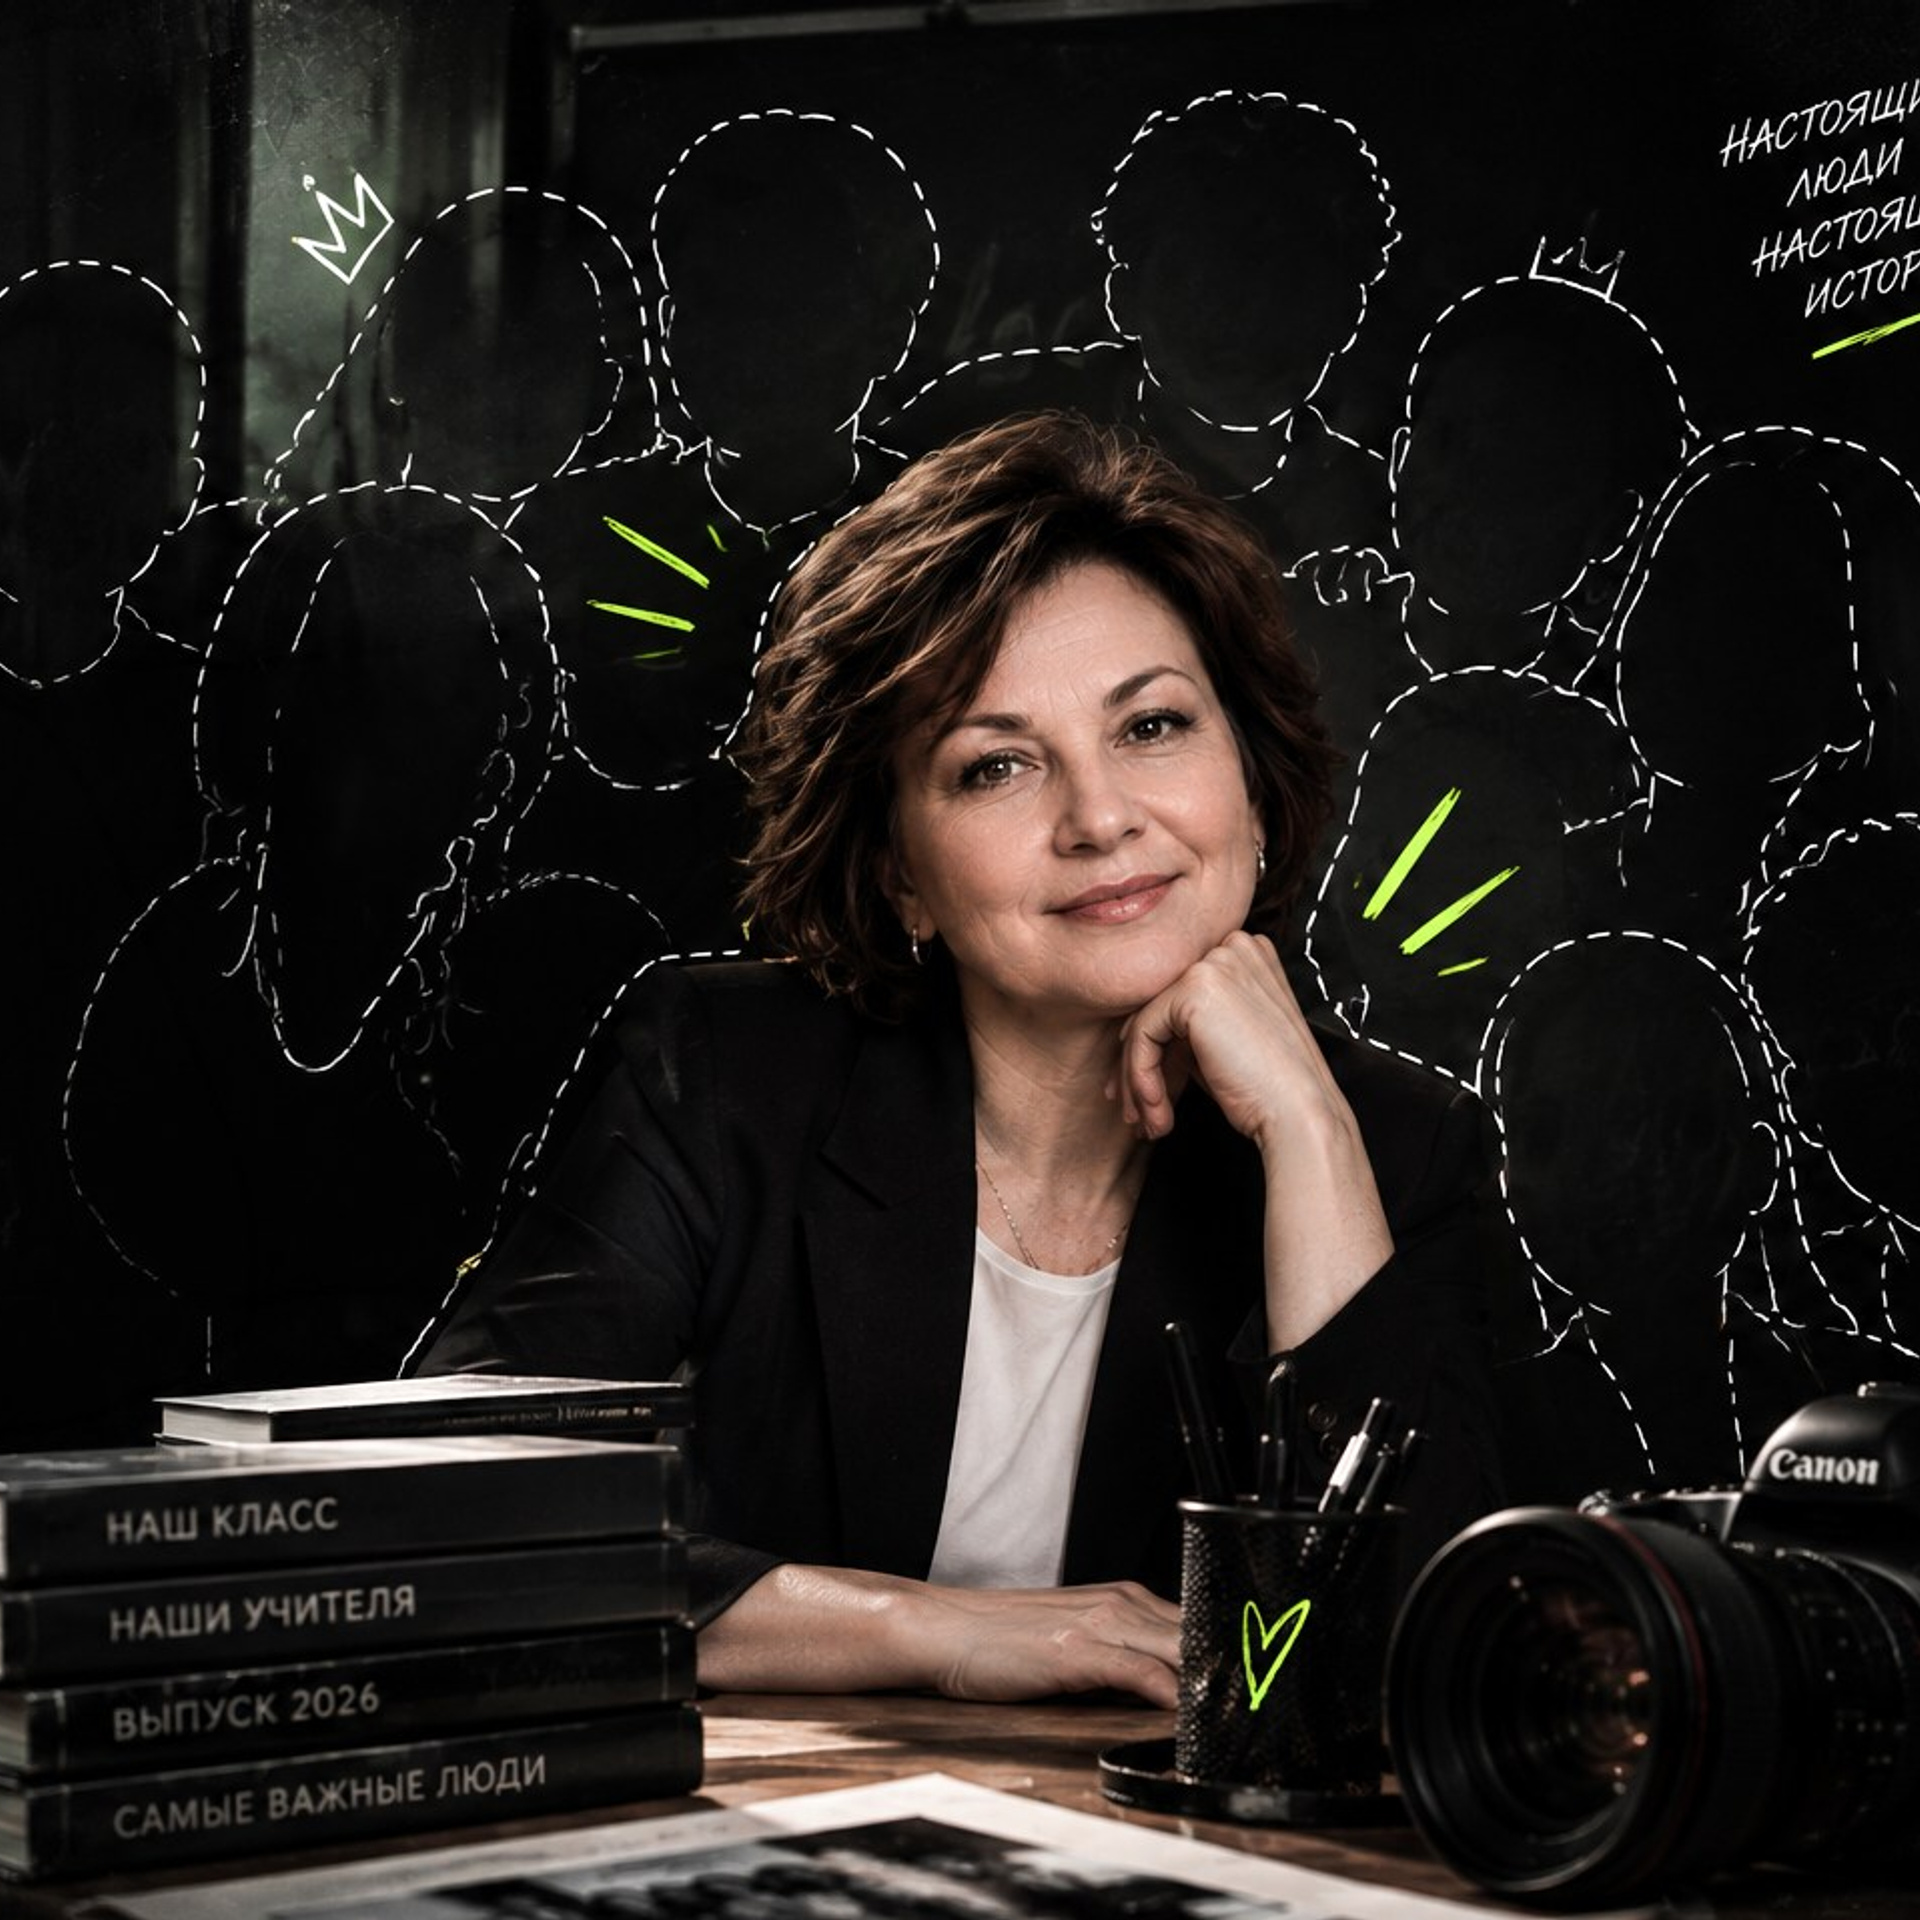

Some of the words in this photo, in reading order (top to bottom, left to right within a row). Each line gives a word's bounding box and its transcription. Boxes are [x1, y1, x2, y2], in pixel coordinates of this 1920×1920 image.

[1786, 136, 1904, 207] ЛЮДИ
[1769, 1448, 1879, 1485] Canon
[107, 1507, 198, 1544] НАШ
[212, 1497, 338, 1538] КЛАСС
[110, 1601, 230, 1642] НАШИ
[245, 1585, 415, 1631] УЧИТЕЛЯ
[113, 1692, 277, 1741] ВЫПУСК
[290, 1682, 379, 1722] 2026
[113, 1790, 254, 1838] САМЫЕ
[268, 1768, 425, 1820] ВАЖНЫЕ
[436, 1753, 546, 1798] ЛЮДИ
